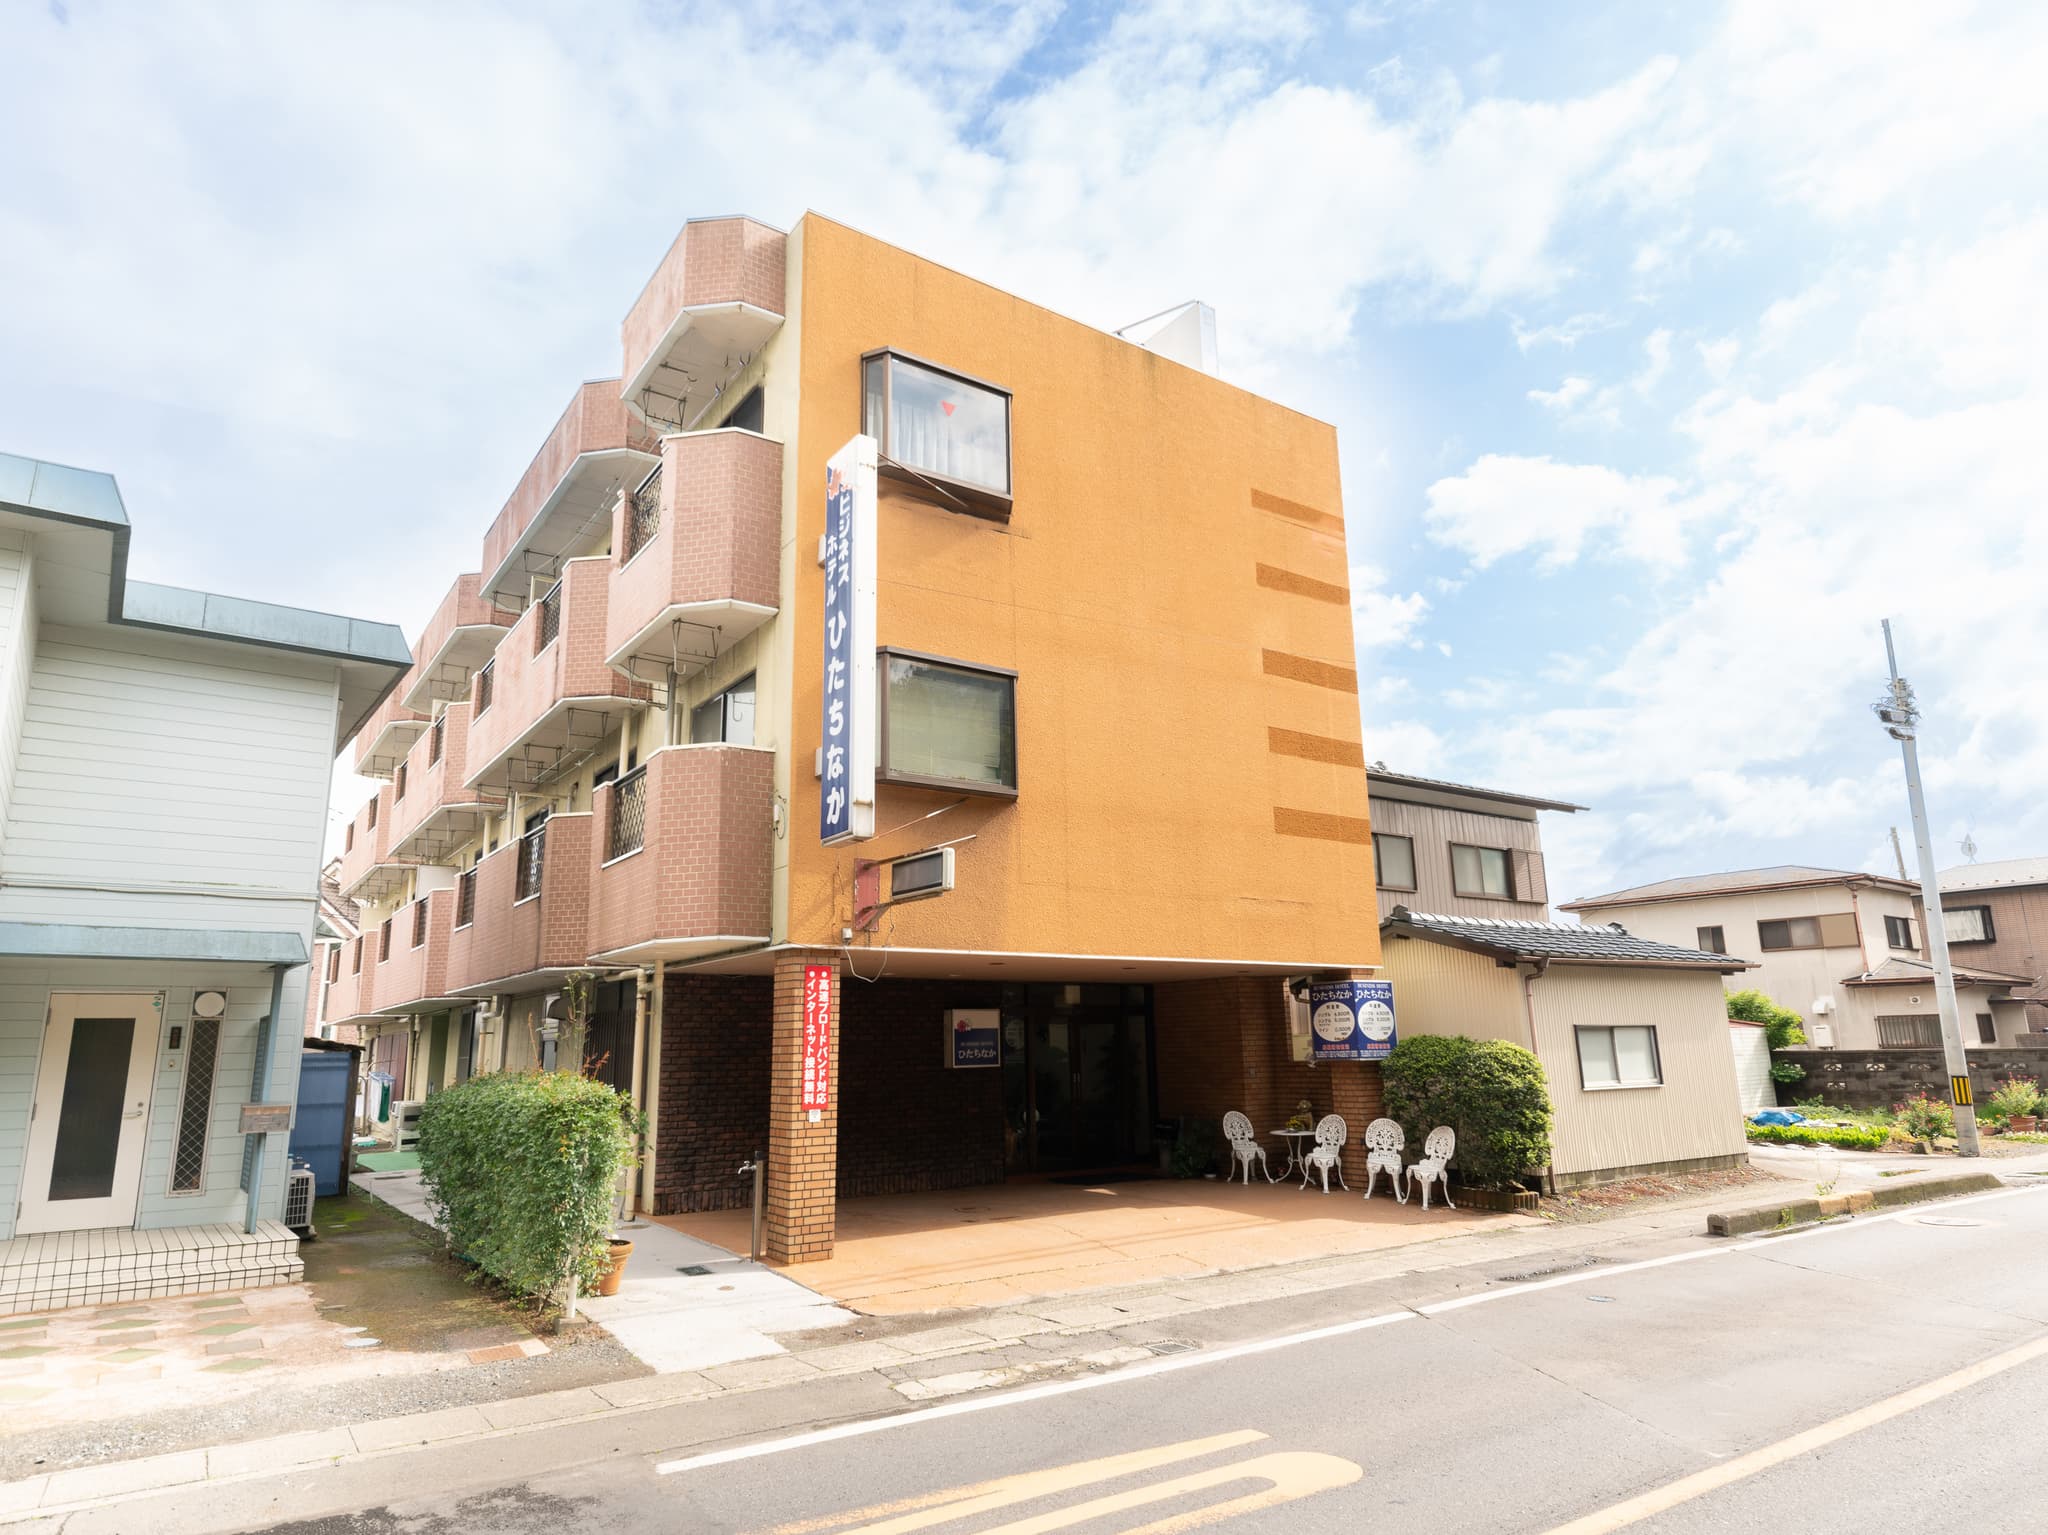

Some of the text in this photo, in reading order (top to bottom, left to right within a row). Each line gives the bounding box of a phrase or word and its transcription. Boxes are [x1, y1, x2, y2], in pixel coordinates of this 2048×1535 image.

[826, 535, 838, 608] ホテル
[838, 494, 850, 587] ビジネス
[826, 609, 848, 825] ひたちなか
[1312, 990, 1353, 1001] ひたちなか
[1356, 989, 1392, 999] ひたちなか
[803, 978, 817, 1104] インターネット接続無料
[816, 979, 830, 1104] 高速ブロードバンド対応
[958, 1048, 997, 1059] ひたちなか
